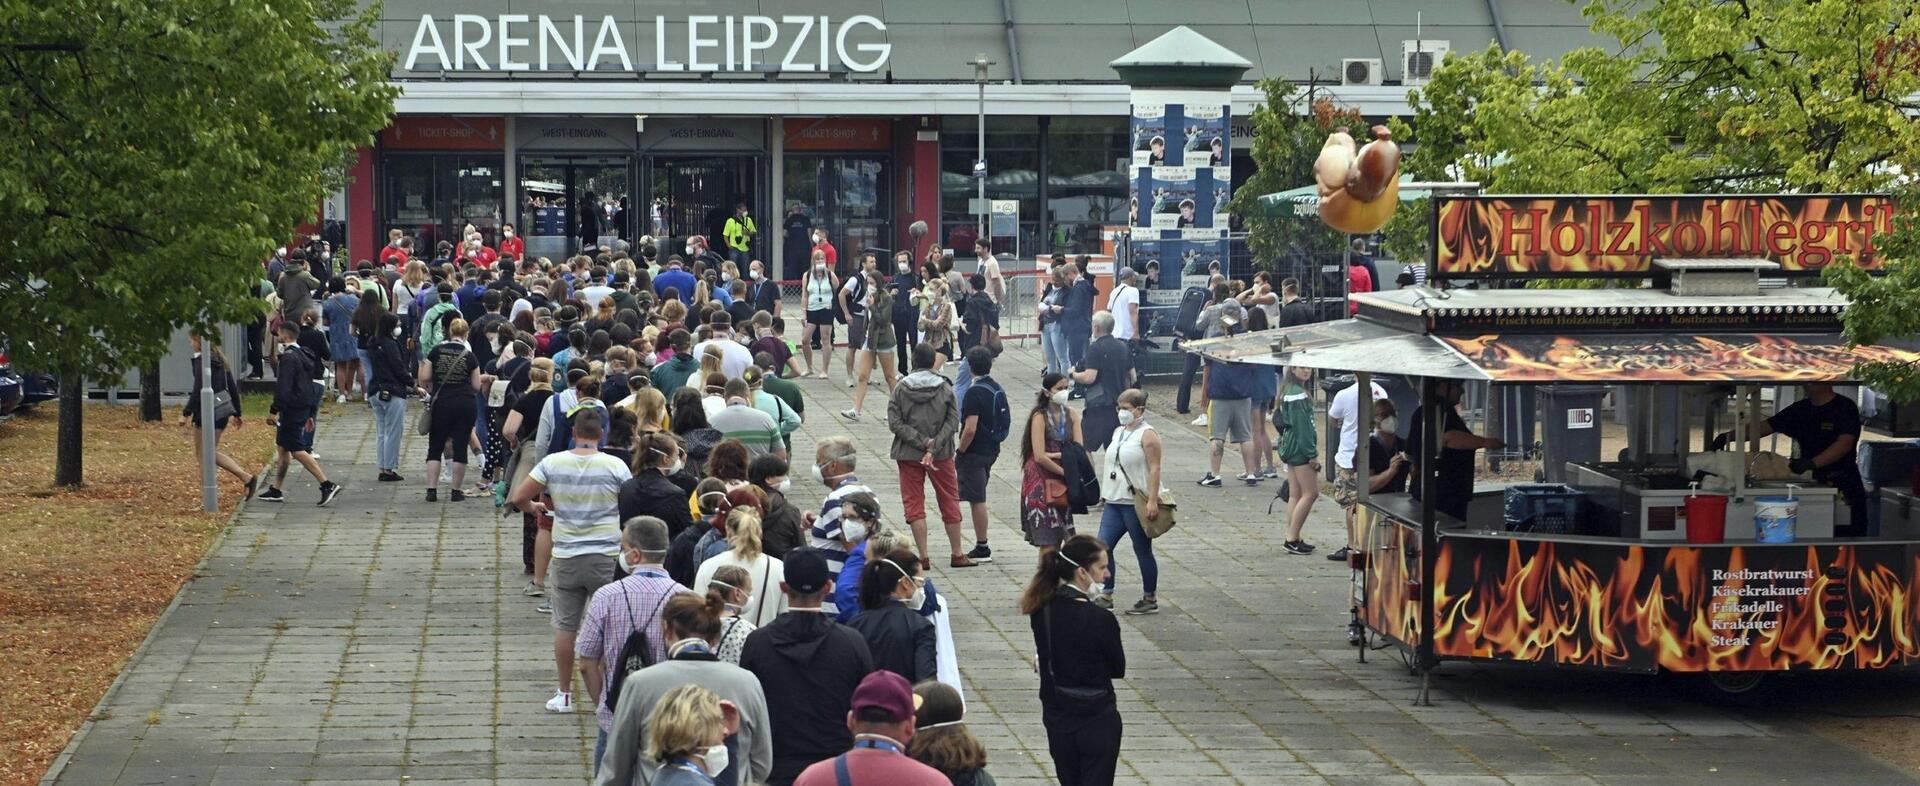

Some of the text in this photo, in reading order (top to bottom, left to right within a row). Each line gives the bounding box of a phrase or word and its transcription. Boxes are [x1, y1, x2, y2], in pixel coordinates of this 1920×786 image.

[405, 14, 892, 72] ARENA LEIPZIG
[417, 127, 473, 137] TICKET-SHOP
[542, 127, 607, 138] WEST-EINGANG
[670, 127, 735, 138] WEST-EINGANG
[802, 127, 857, 138] TICKET-SHOP
[1497, 204, 1894, 268] Holzkohlegril
[1557, 314, 1636, 326] Holzkohlegrill
[1671, 314, 1749, 324] Rostbratwurst
[1712, 568, 1814, 580] Rostbratwurst
[1712, 584, 1811, 597] Käsekrakauer
[1712, 601, 1784, 613] Frikadelle
[1712, 619, 1779, 630] Krakauer
[1712, 635, 1751, 646] Steak
